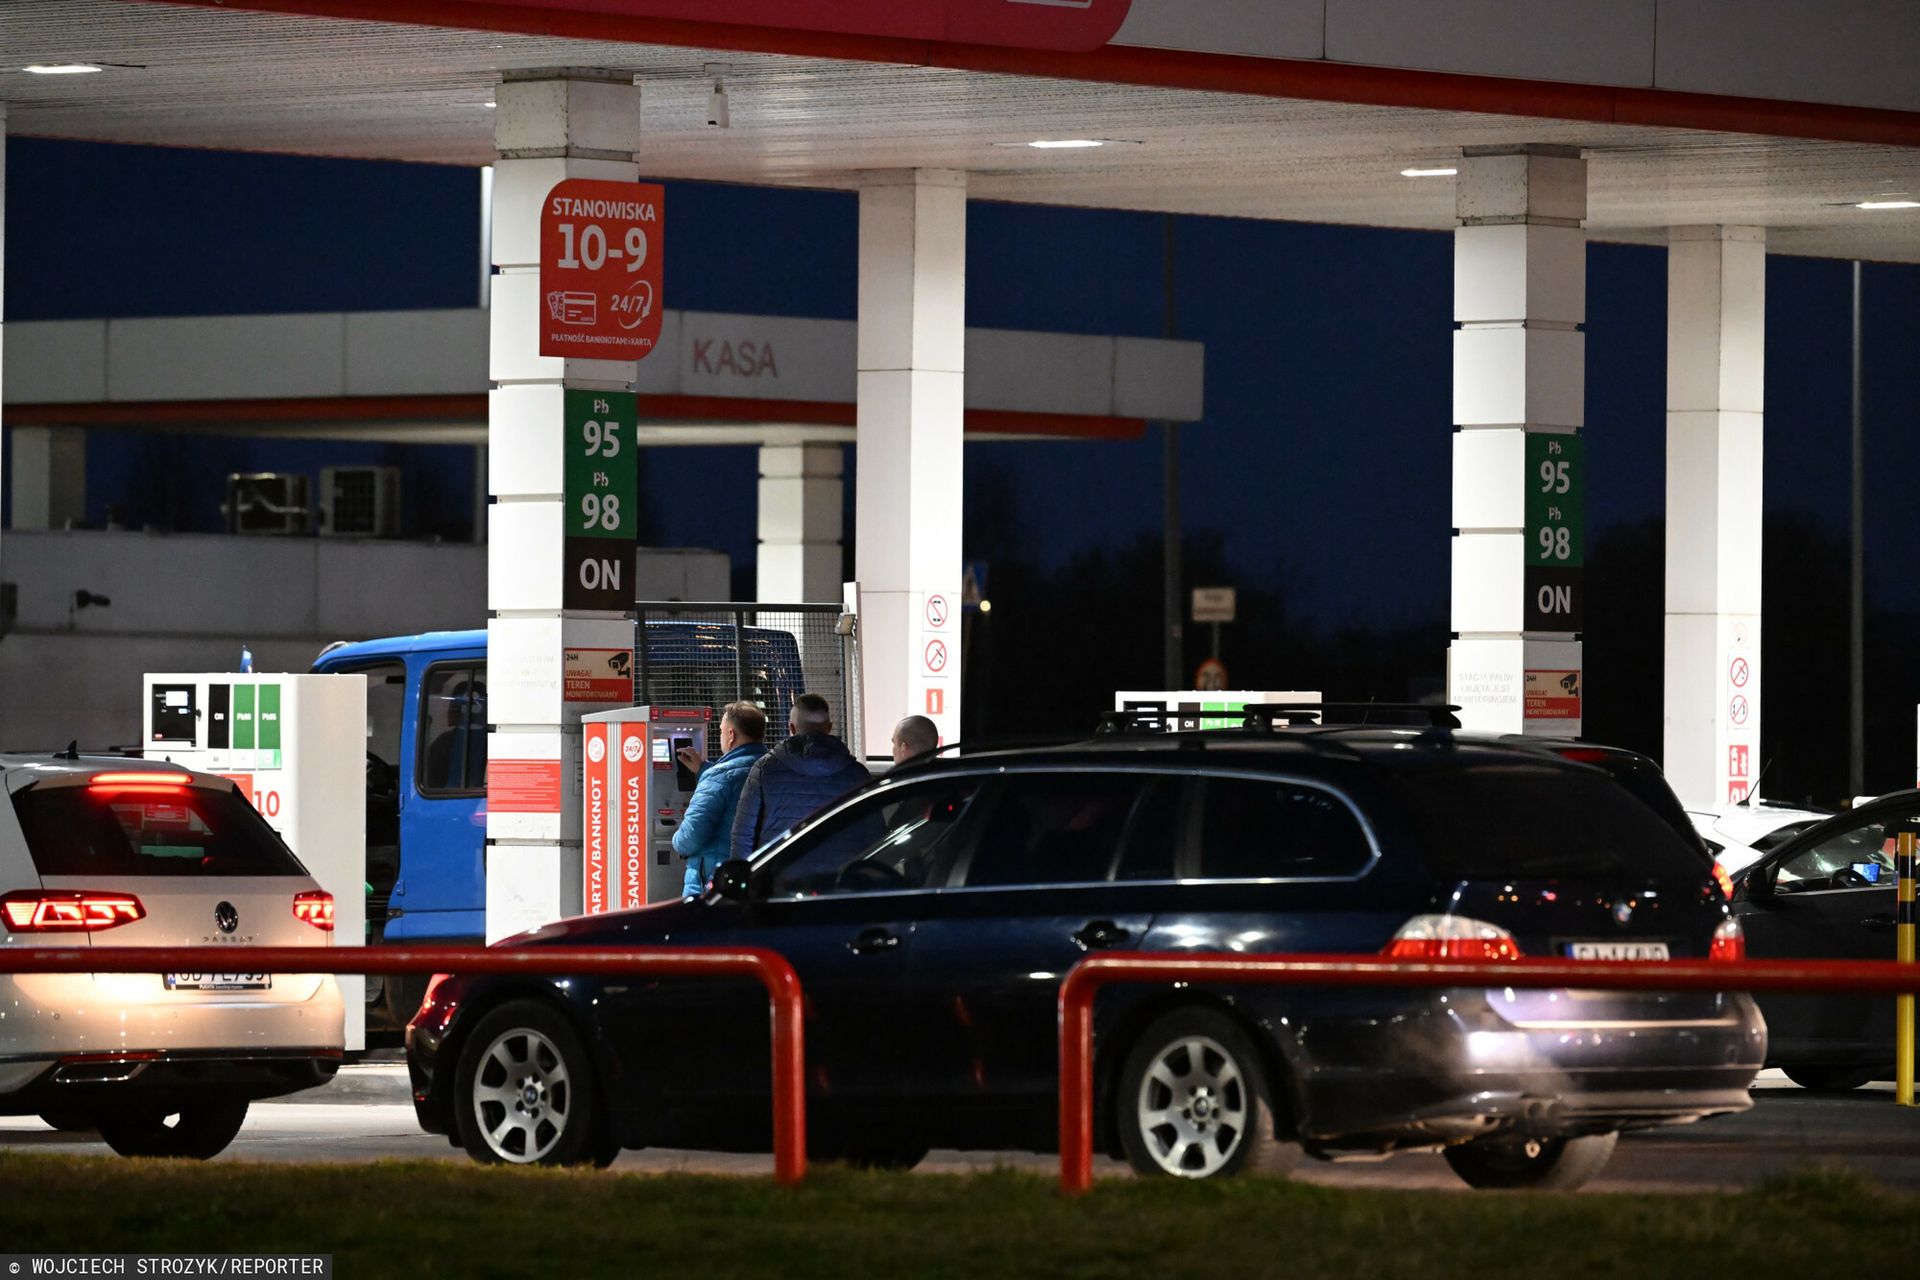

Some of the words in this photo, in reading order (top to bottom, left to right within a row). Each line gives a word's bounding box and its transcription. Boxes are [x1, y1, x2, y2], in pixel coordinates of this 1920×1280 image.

[553, 198, 656, 222] STANOWISKA
[558, 224, 647, 272] 10-9
[610, 294, 644, 313] 24/7
[552, 333, 585, 344] PŁATNOŚĆ
[586, 336, 627, 346] BANKNOTAMI
[693, 337, 777, 378] KASA
[593, 399, 609, 414] Pb
[583, 420, 620, 457] 95
[1549, 441, 1561, 454] Pb
[593, 472, 609, 487] Pb
[1540, 461, 1570, 494] 95
[582, 493, 620, 530] 98
[1549, 506, 1561, 520] Pb
[1540, 527, 1570, 559] 98
[580, 558, 620, 590] ON
[1538, 585, 1571, 613] ON
[566, 653, 579, 661] 24H
[566, 669, 592, 677] UWAGA!
[566, 680, 590, 689] TEREN
[254, 790, 280, 818] 10
[591, 776, 603, 915] ARTA/BANKNOT
[627, 776, 640, 909] SAMOOBSŁUGA
